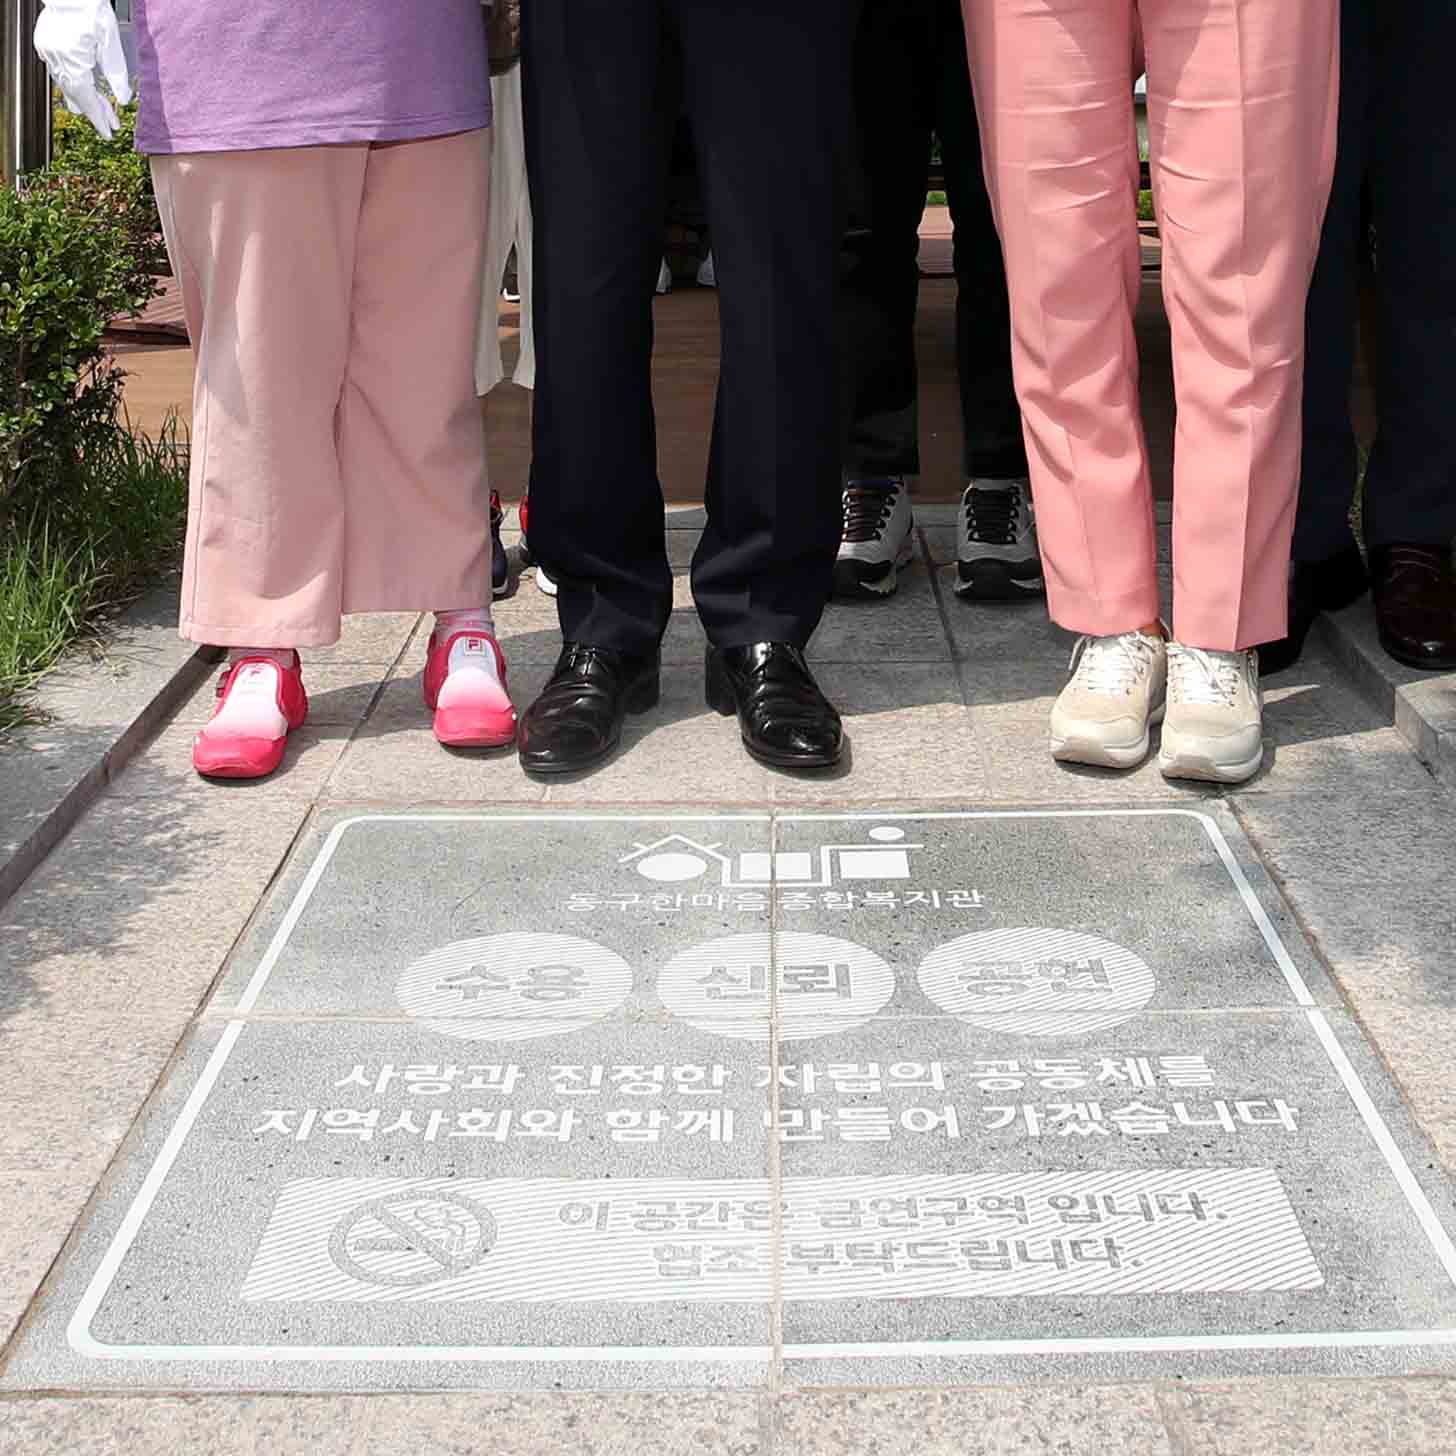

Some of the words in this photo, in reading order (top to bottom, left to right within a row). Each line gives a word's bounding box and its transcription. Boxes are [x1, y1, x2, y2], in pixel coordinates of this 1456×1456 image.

[566, 888, 986, 913] 동구한마음종합복지관
[434, 963, 591, 1001] 수용
[695, 963, 853, 1000] 신뢰
[956, 958, 1114, 999] 공헌
[335, 1063, 527, 1096] 사랑과
[548, 1062, 732, 1096] 진정한
[752, 1060, 945, 1095] 자립의
[969, 1055, 1217, 1091] 공동체를
[251, 1108, 583, 1143] 지역사회와
[604, 1108, 736, 1143] 함께
[762, 1104, 961, 1142] 만들어
[983, 1098, 1299, 1138] 가겠습니다
[558, 1200, 610, 1231] 이
[631, 1200, 794, 1231] 공간은
[813, 1193, 1028, 1231] 금연구역
[652, 1244, 760, 1278] 협조
